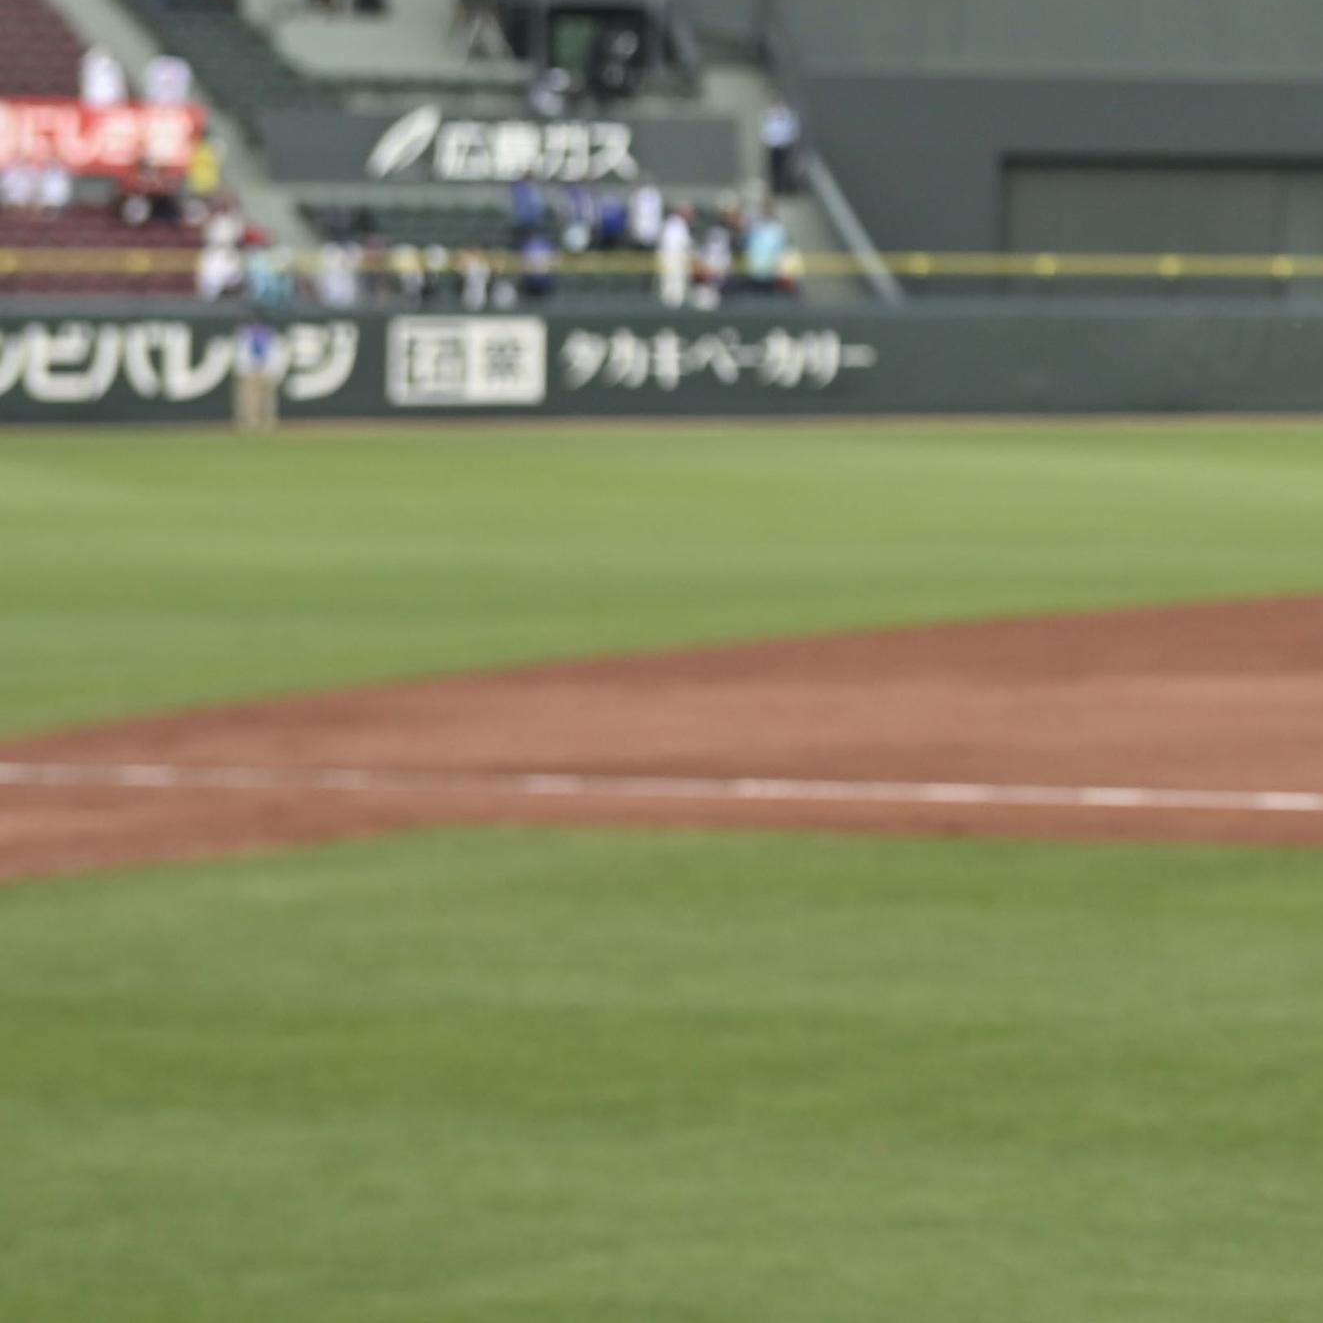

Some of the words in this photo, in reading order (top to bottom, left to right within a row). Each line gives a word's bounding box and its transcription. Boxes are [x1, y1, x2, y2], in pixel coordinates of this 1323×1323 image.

[434, 118, 640, 182] 広島ガス
[560, 327, 877, 390] タカキベーカリー
